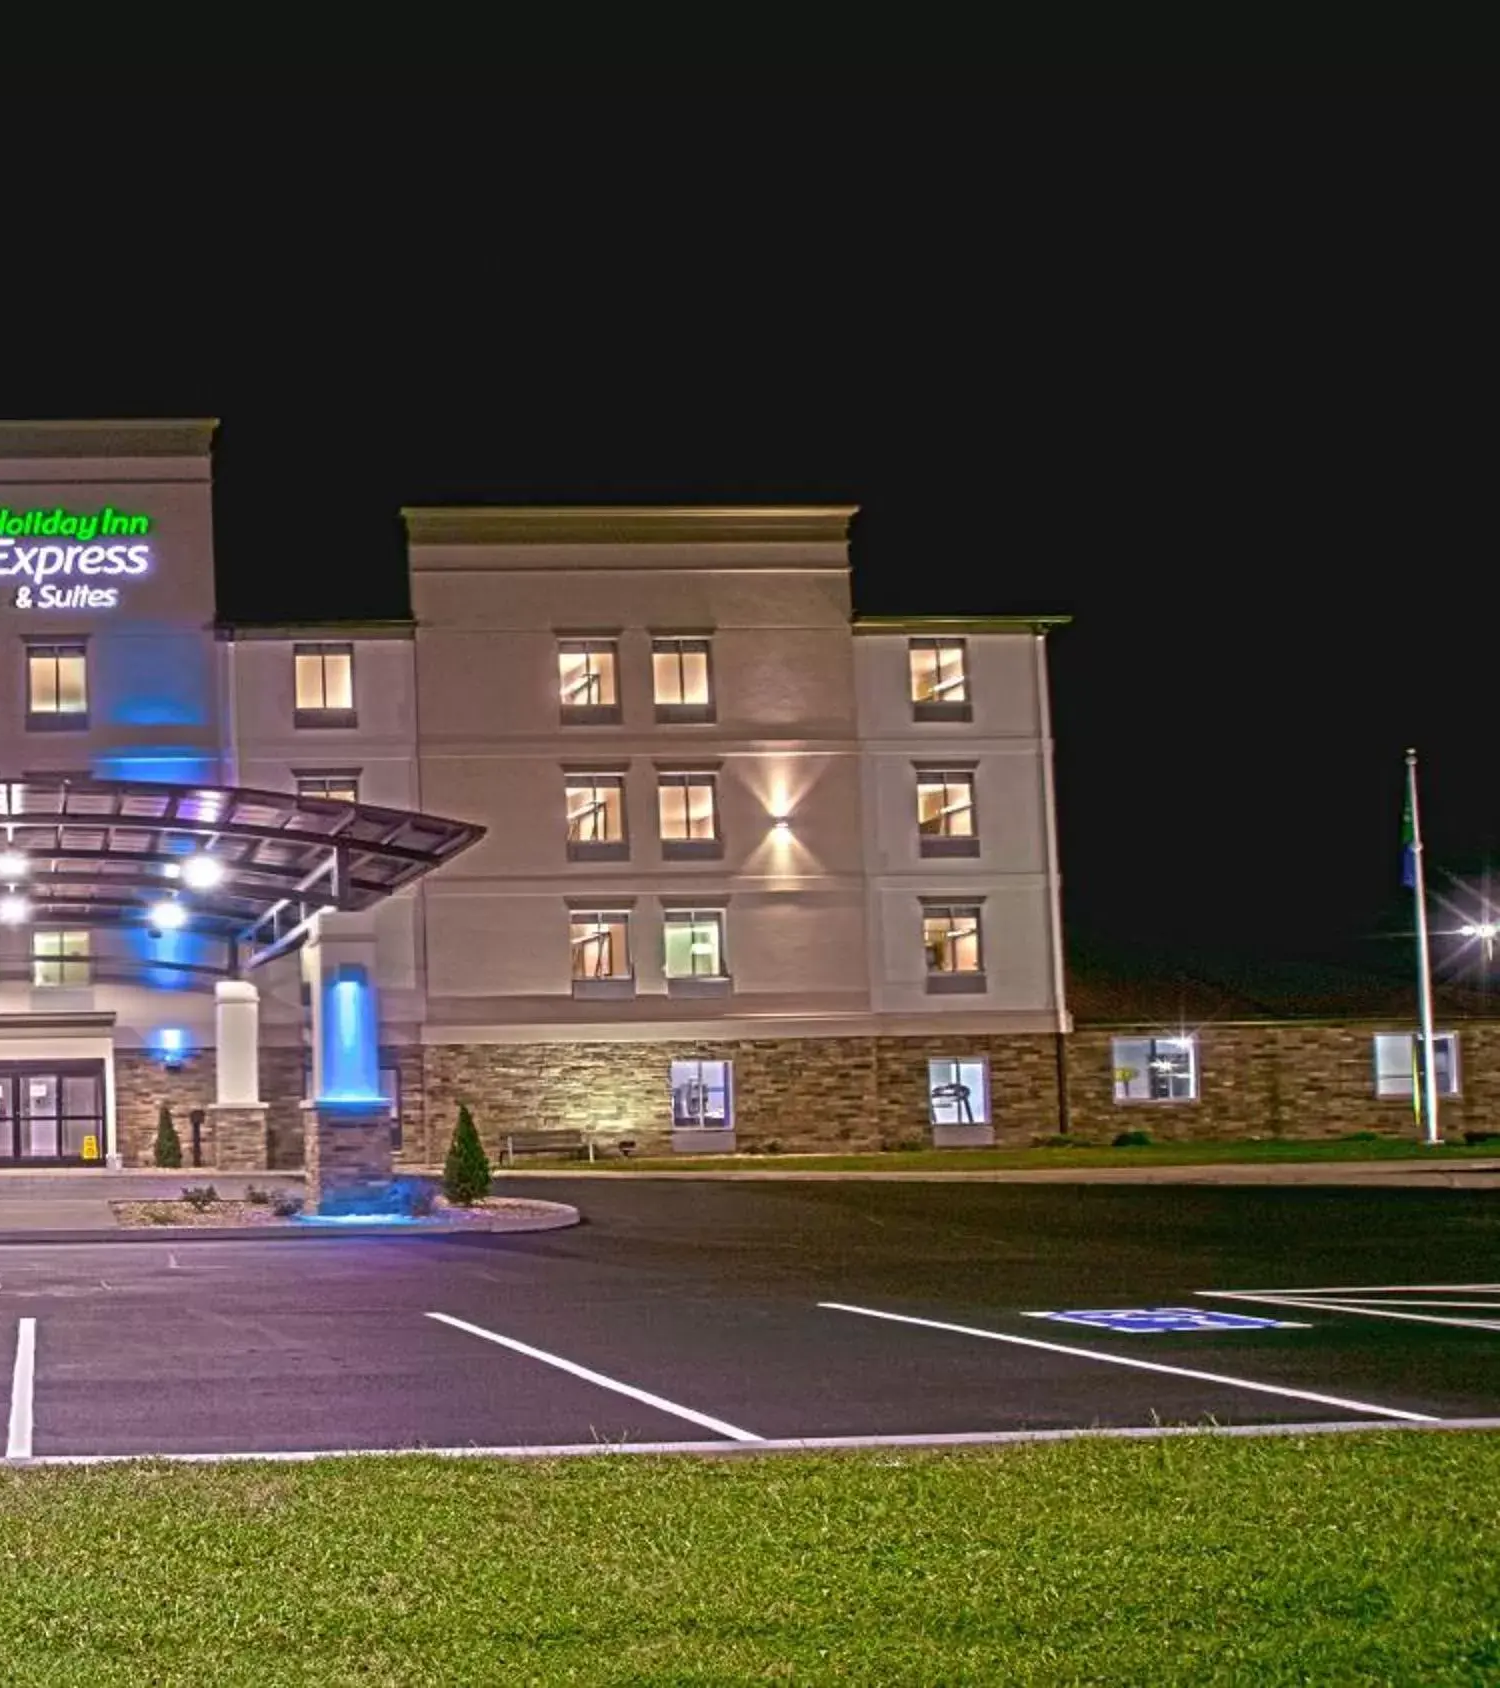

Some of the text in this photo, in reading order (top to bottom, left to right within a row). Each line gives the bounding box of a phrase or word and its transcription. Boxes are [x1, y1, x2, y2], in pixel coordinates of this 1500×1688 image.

[102, 508, 149, 535] Inn
[15, 584, 119, 609] & Suites
